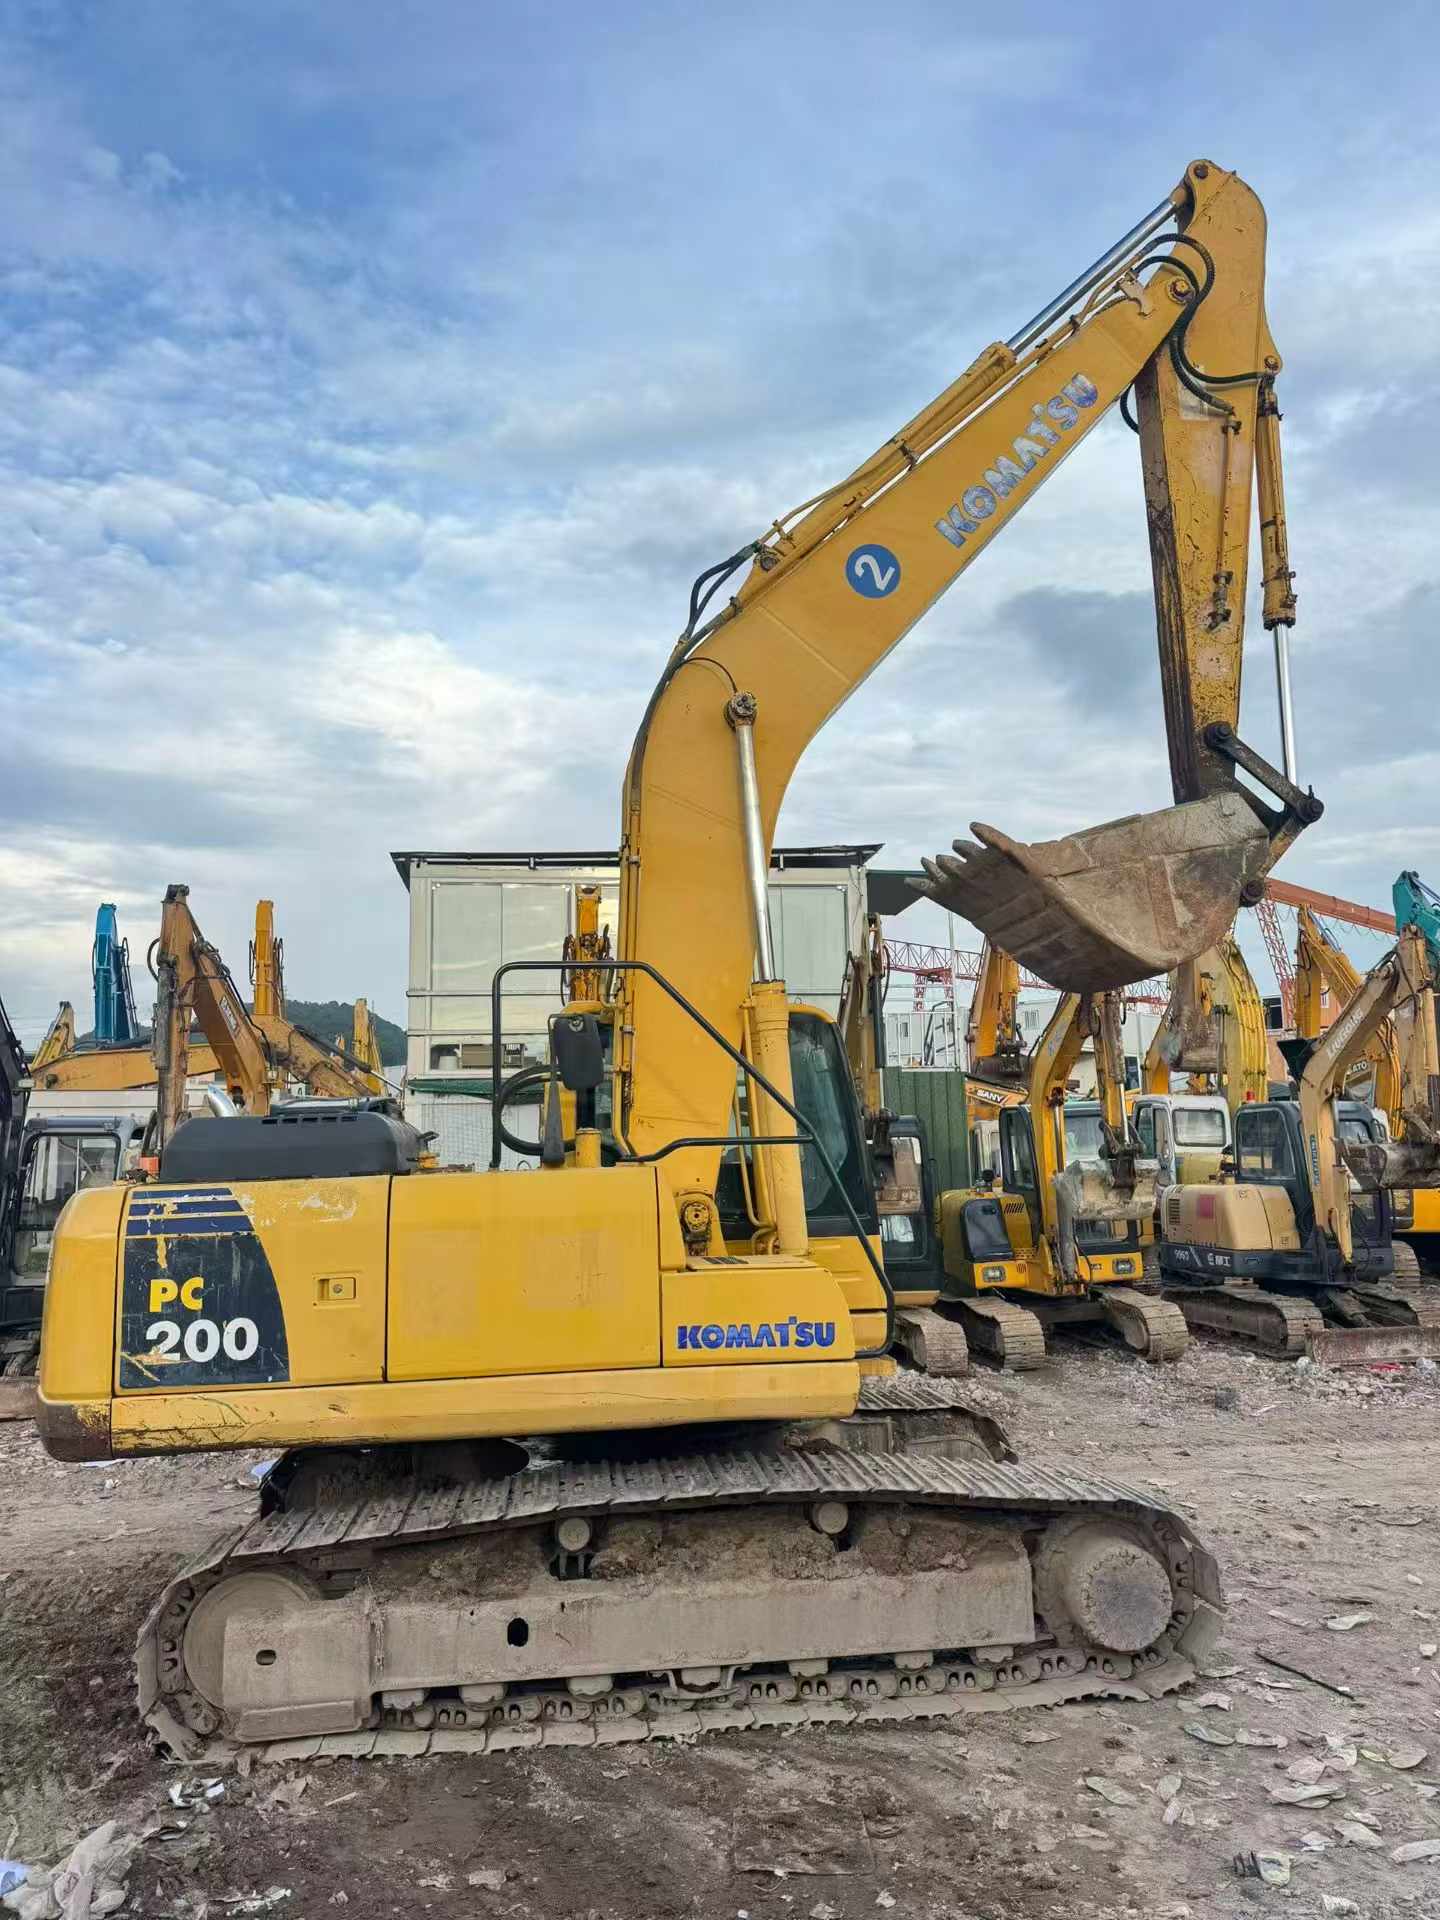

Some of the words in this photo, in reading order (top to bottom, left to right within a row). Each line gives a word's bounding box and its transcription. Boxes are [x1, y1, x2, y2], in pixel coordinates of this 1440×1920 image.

[934, 372, 1098, 549] KOMATSU
[854, 553, 896, 592] 2
[1327, 1008, 1364, 1060] LIUGONG
[976, 1089, 1005, 1103] SANY
[149, 1276, 205, 1312] PC
[145, 1317, 259, 1363] 200
[677, 1315, 836, 1350] KOMATSU
